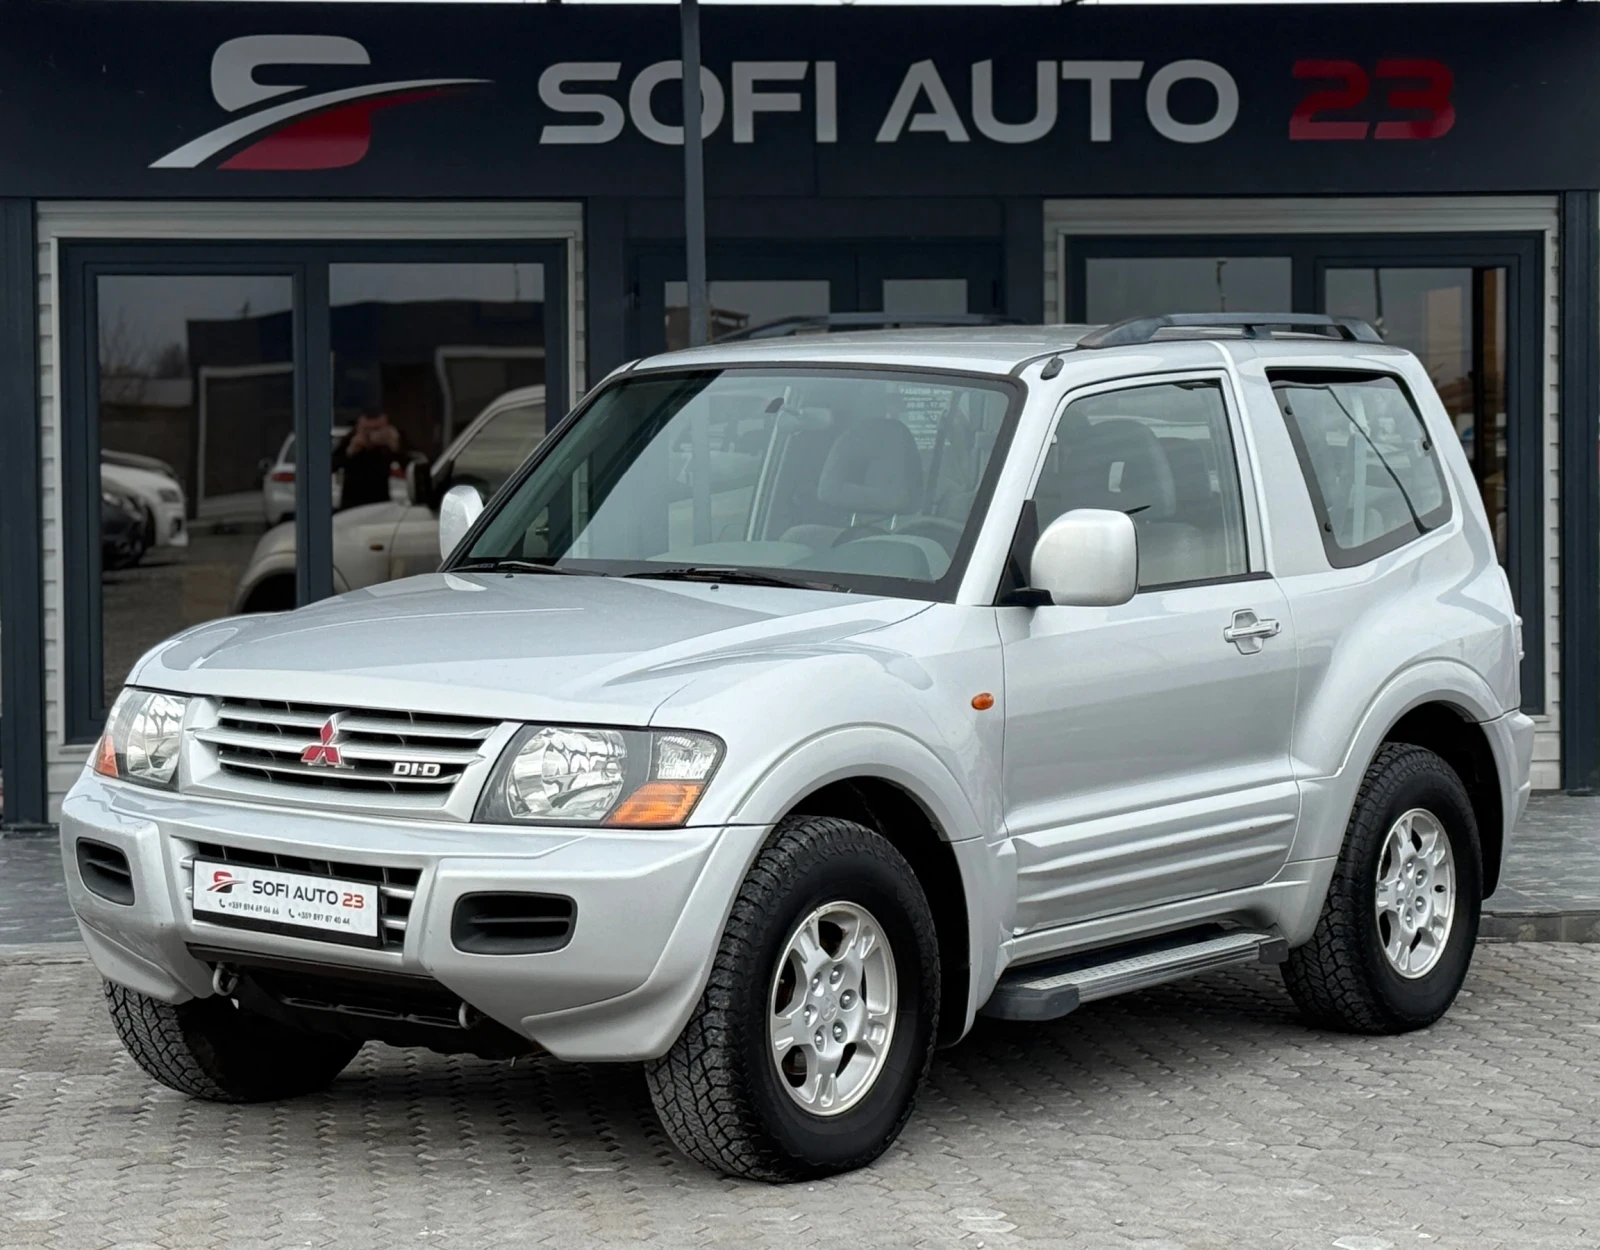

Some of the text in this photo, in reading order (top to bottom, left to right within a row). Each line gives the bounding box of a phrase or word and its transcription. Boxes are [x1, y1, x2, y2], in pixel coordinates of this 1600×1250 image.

[538, 59, 1456, 145] SOFI AUTO 23
[252, 880, 365, 909] SOFI AUTO 23
